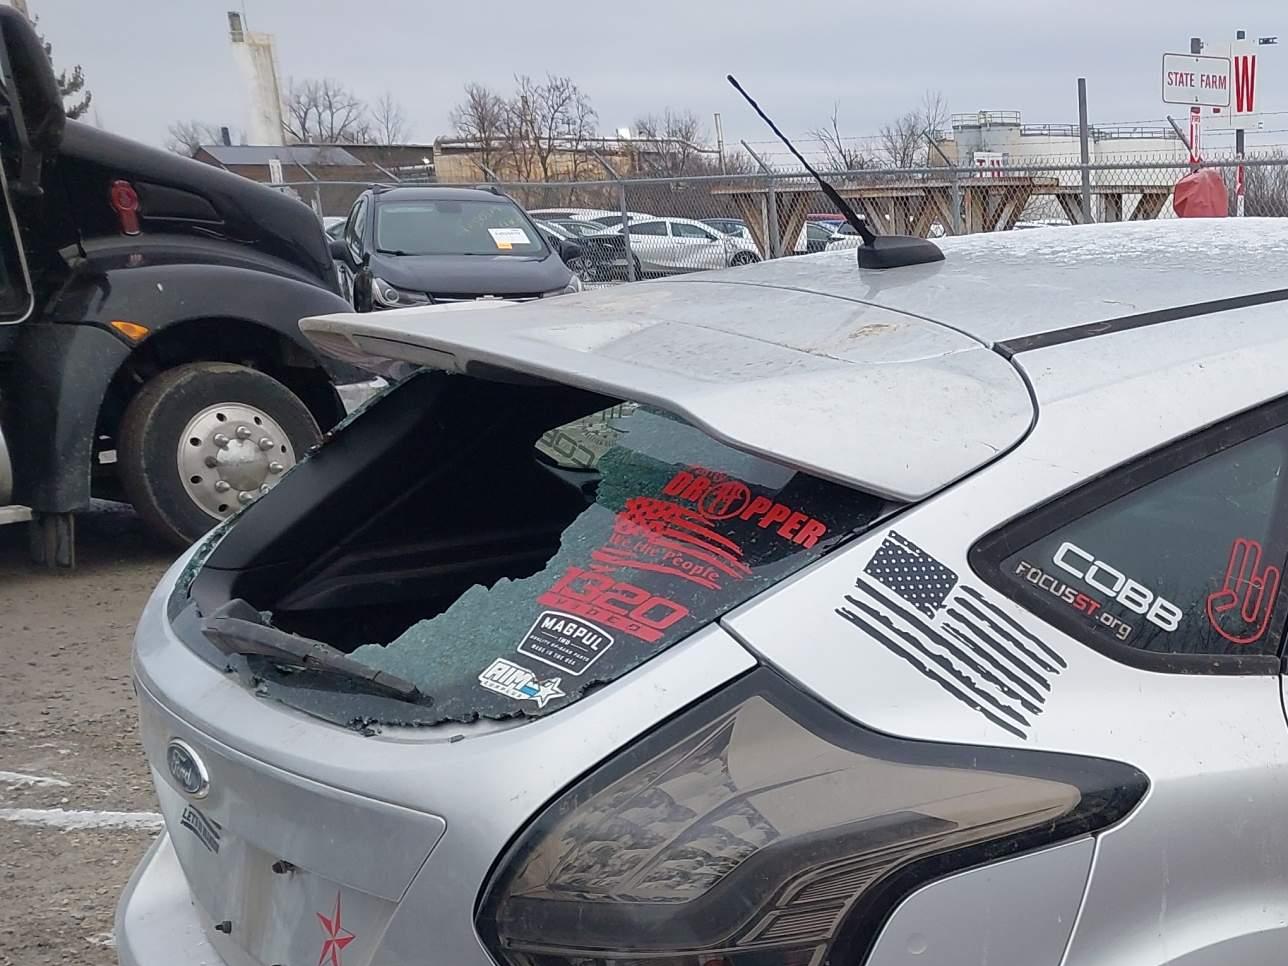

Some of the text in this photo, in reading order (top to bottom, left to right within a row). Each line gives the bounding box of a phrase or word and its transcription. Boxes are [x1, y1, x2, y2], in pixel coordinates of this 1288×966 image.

[1167, 72, 1227, 90] STATE FARM
[1234, 55, 1256, 112] W
[663, 549, 720, 581] People
[1052, 541, 1184, 632] COBB
[550, 566, 689, 631] 1320
[1015, 561, 1133, 641] FOCUSST.org
[540, 616, 603, 651] MAGPUL
